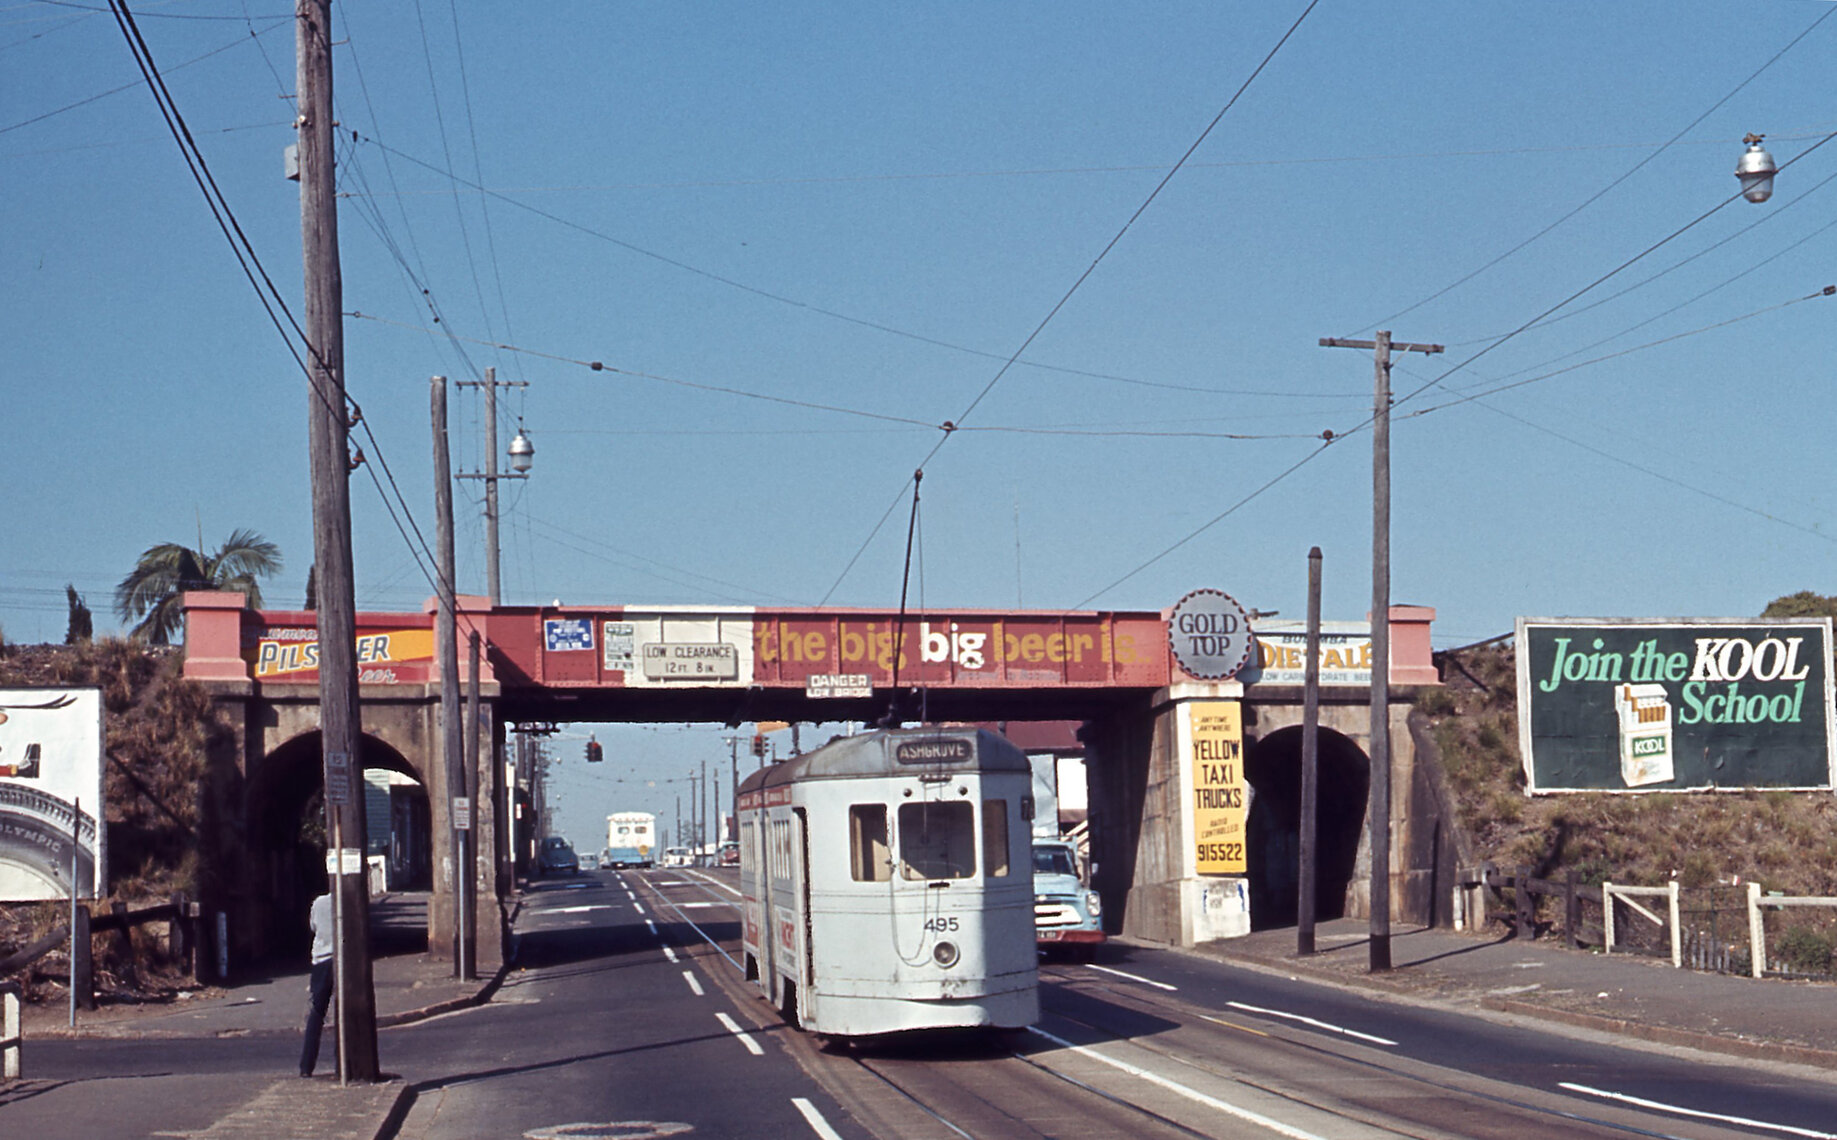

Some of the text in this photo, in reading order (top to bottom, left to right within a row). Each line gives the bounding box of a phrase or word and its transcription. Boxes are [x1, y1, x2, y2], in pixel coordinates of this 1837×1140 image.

[1179, 614, 1238, 634] GOLD
[259, 635, 391, 674] PILSER
[647, 647, 731, 658] LOW CLEARANCE
[756, 622, 826, 662] the
[841, 622, 908, 671] big
[920, 622, 987, 669] big
[992, 622, 1093, 663] beer
[1189, 636, 1230, 656] TOP
[696, 661, 703, 673] 8
[1539, 637, 1811, 693] Join the KOOL
[357, 667, 399, 684] eer
[811, 674, 867, 687] DANGER
[807, 688, 872, 698] LOW BRIDGE
[1678, 680, 1806, 725] School
[900, 744, 965, 759] ASHGROVE
[1193, 739, 1240, 760] YELLOW
[1635, 738, 1665, 754] KOOL
[1202, 764, 1233, 784] TAXI
[1195, 788, 1241, 809] TRUCKS
[1198, 843, 1243, 861] 915522
[924, 917, 959, 932] 495
